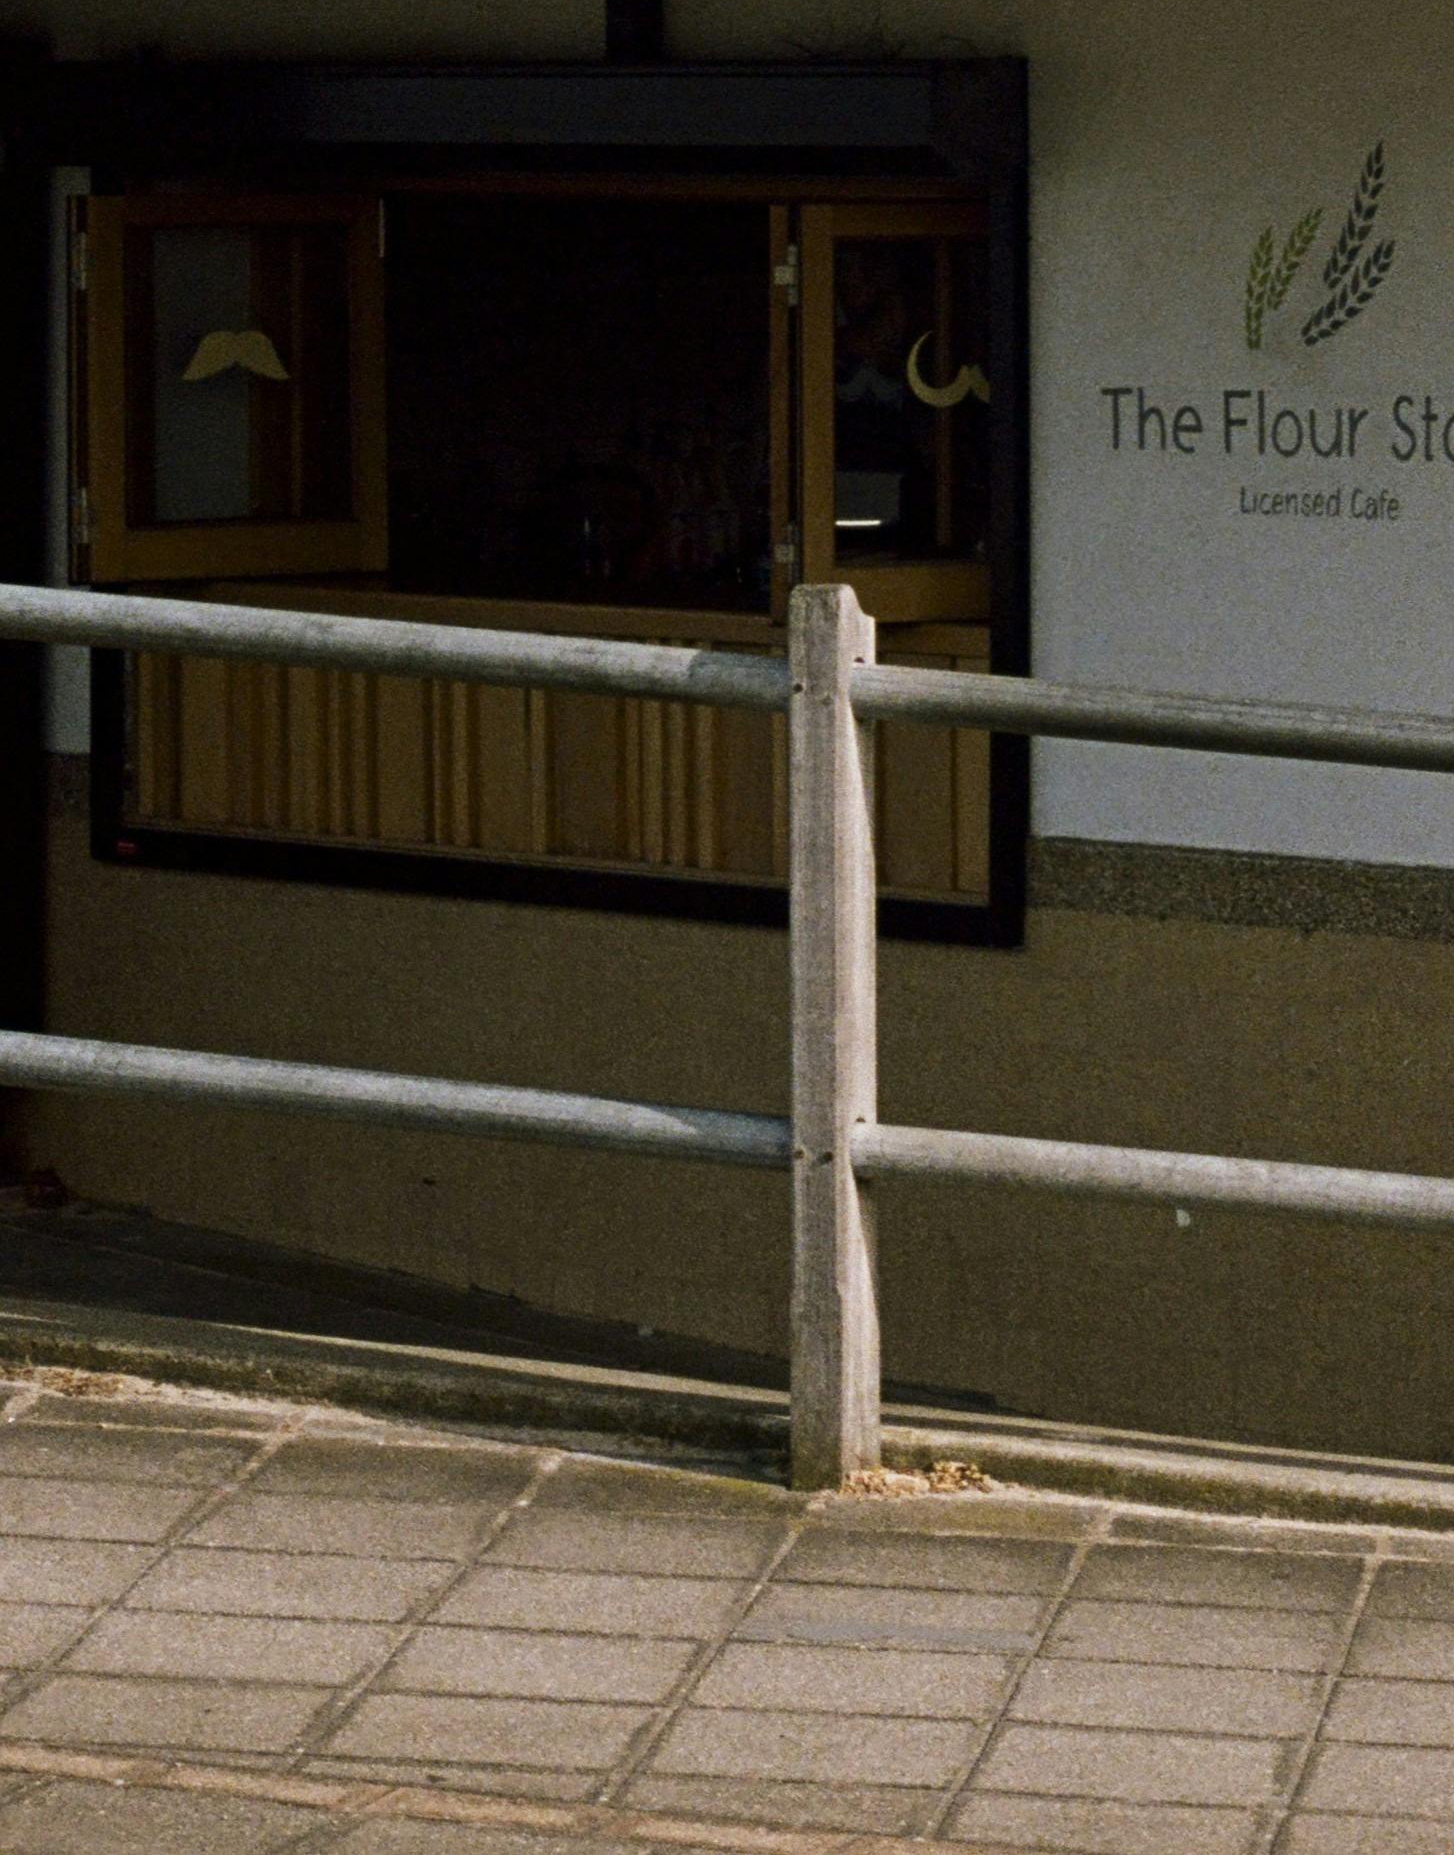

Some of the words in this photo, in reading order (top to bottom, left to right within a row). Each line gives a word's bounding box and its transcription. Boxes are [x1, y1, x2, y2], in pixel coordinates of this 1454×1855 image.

[1101, 387, 1204, 455] The
[1223, 389, 1369, 459] Flour
[1239, 486, 1341, 519] Licensed
[1350, 487, 1401, 522] Cafe
